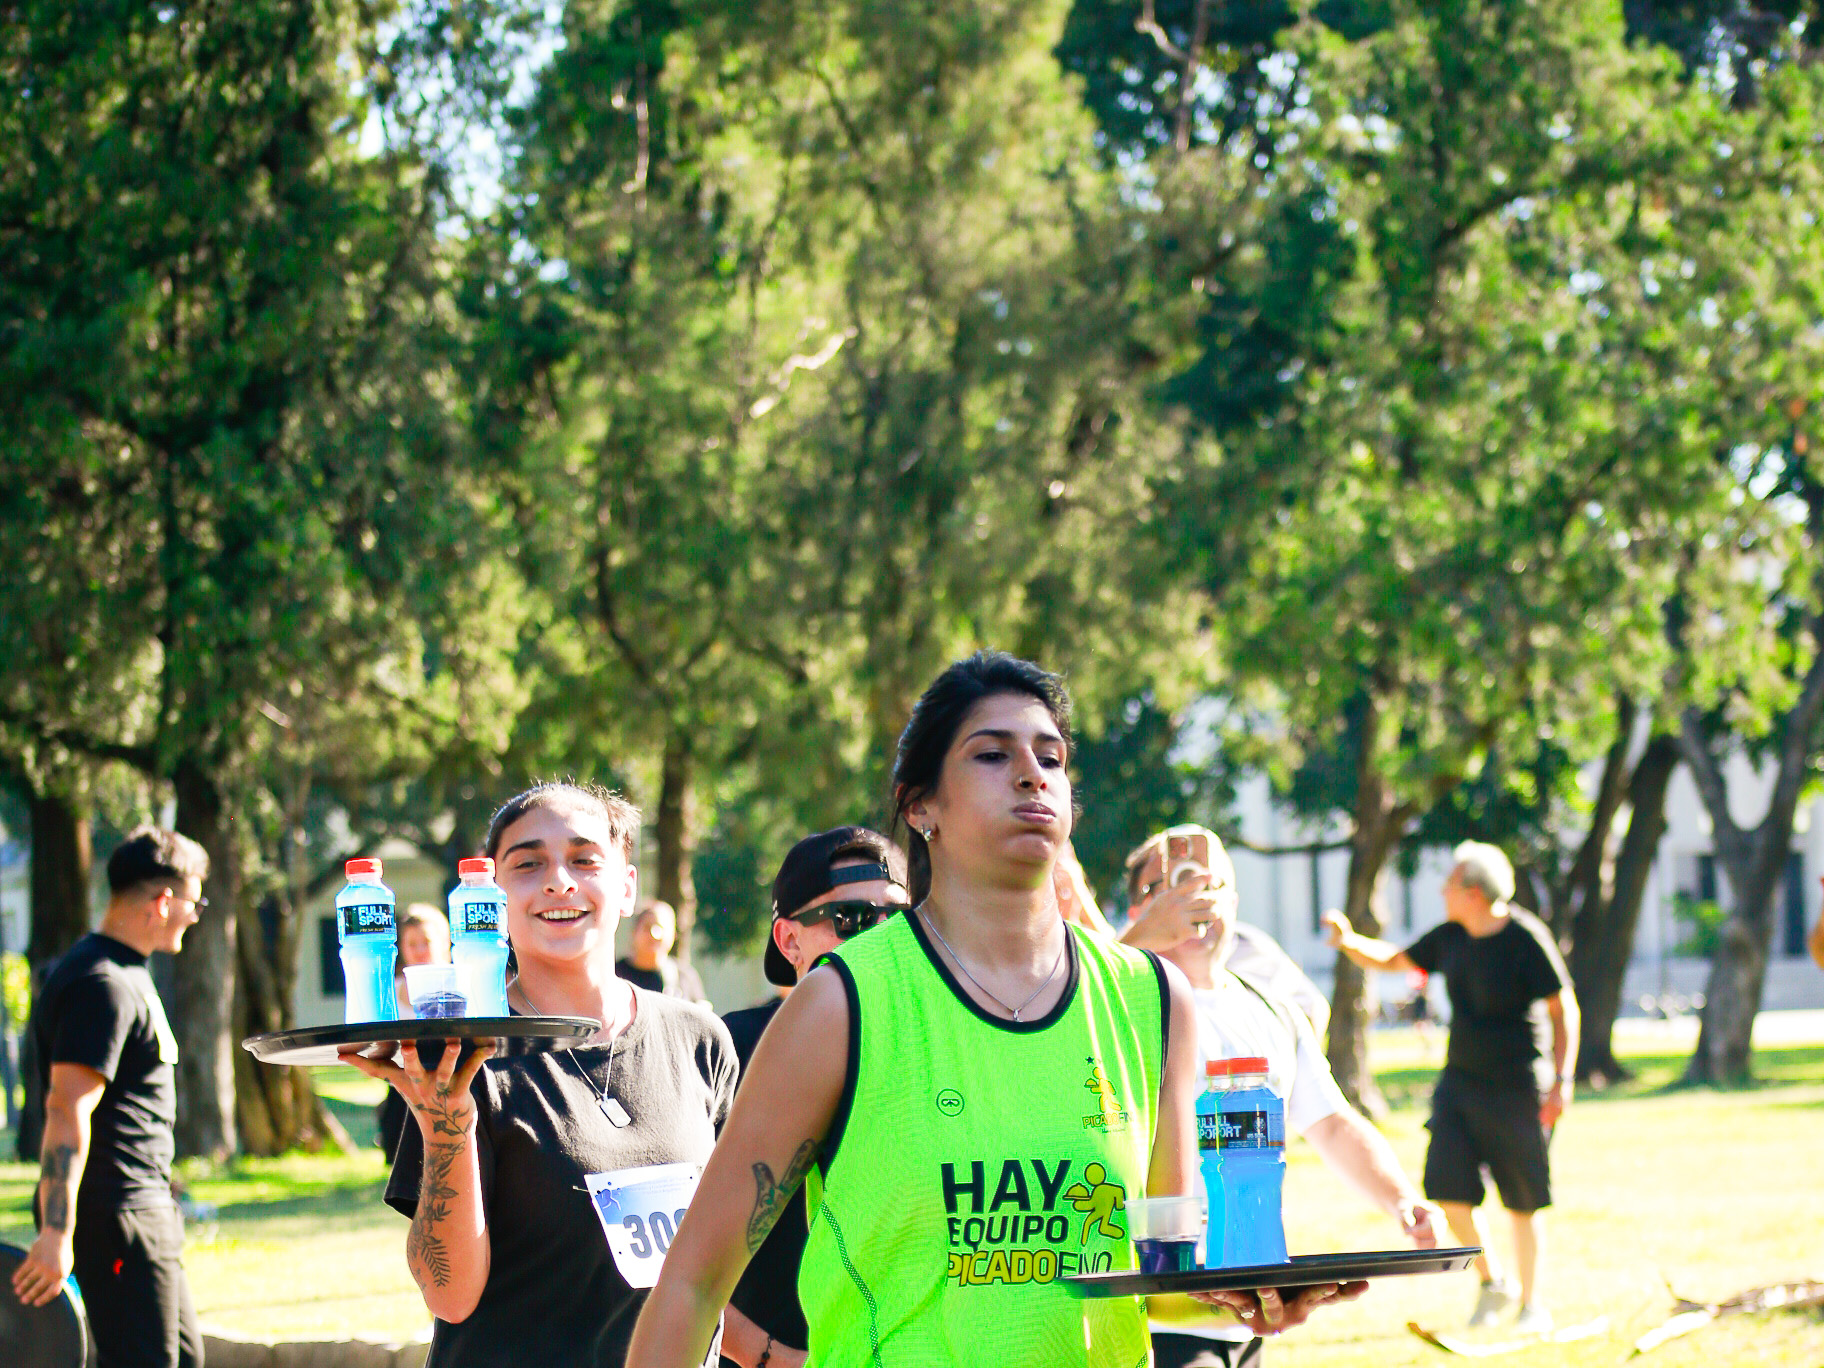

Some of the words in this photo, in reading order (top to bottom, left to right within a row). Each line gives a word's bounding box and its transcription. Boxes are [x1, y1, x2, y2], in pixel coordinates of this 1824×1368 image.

[358, 905, 387, 917] FULL
[467, 903, 495, 915] FULL
[358, 914, 393, 926] SPORT
[467, 913, 498, 924] SPOR
[1218, 1125, 1242, 1138] ORT
[940, 1159, 1072, 1214] HAY
[947, 1215, 1069, 1252] EQUIPO
